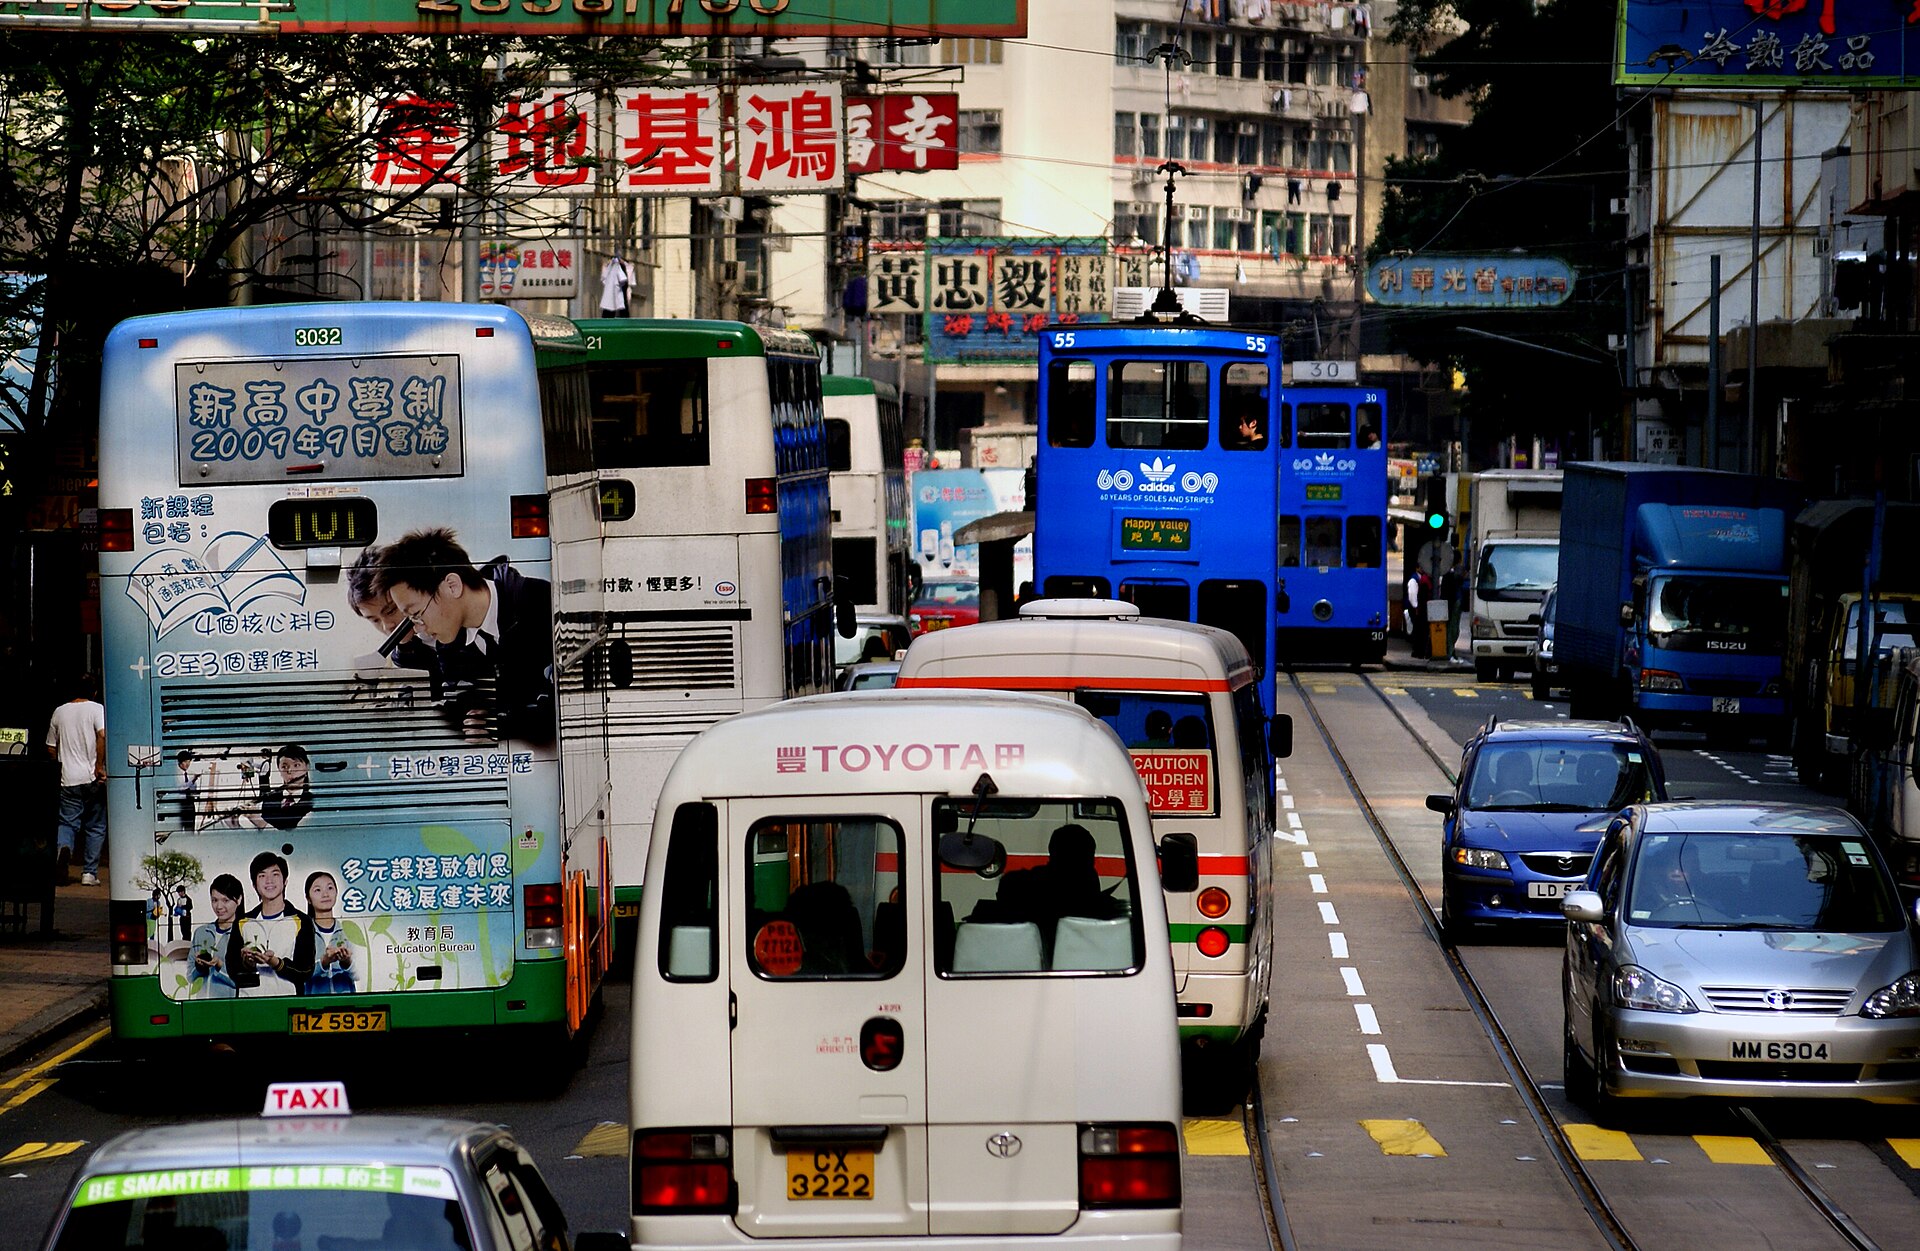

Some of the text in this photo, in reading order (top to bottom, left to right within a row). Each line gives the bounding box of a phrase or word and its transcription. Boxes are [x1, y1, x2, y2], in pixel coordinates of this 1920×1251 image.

[1699, 28, 1875, 72] 冷熱飲品
[296, 329, 341, 346] 3032
[1054, 332, 1076, 348] 55
[1246, 336, 1267, 352] 55
[1311, 363, 1339, 377] 30
[190, 375, 446, 428] 新高中學制
[1365, 394, 1377, 403] 30
[191, 421, 448, 462] 2009年9月實施
[1097, 469, 1219, 494] 60 09
[1139, 483, 1175, 492] adidas
[141, 494, 214, 519] 新課程
[600, 487, 623, 515] 4
[1185, 496, 1214, 504] STRIPES
[1125, 519, 1156, 531] Happy
[1131, 531, 1183, 543] 跑馬地
[194, 610, 335, 636] 4個核心科目
[1371, 631, 1384, 641] 30
[1706, 641, 1747, 651] ISUZU
[156, 649, 319, 677] 2至3個選修科
[390, 752, 533, 778] 其他學習經歷
[812, 743, 989, 773] TOYOTA
[1133, 757, 1200, 770] CAUTION
[1141, 773, 1205, 786] HILDREN
[1150, 789, 1205, 808] 心學童
[342, 882, 513, 912] 全人發展建未來
[1537, 884, 1557, 897] LD
[407, 926, 454, 941] 教育局
[386, 942, 475, 954] Education Bureau
[297, 1013, 383, 1030] HZ 5937
[1732, 1041, 1828, 1060] MM 6304
[272, 1088, 339, 1110] TAXI
[814, 1149, 848, 1173] CX
[87, 1181, 117, 1202] BE
[121, 1168, 230, 1196] SMARTER
[792, 1173, 869, 1197] 3222
